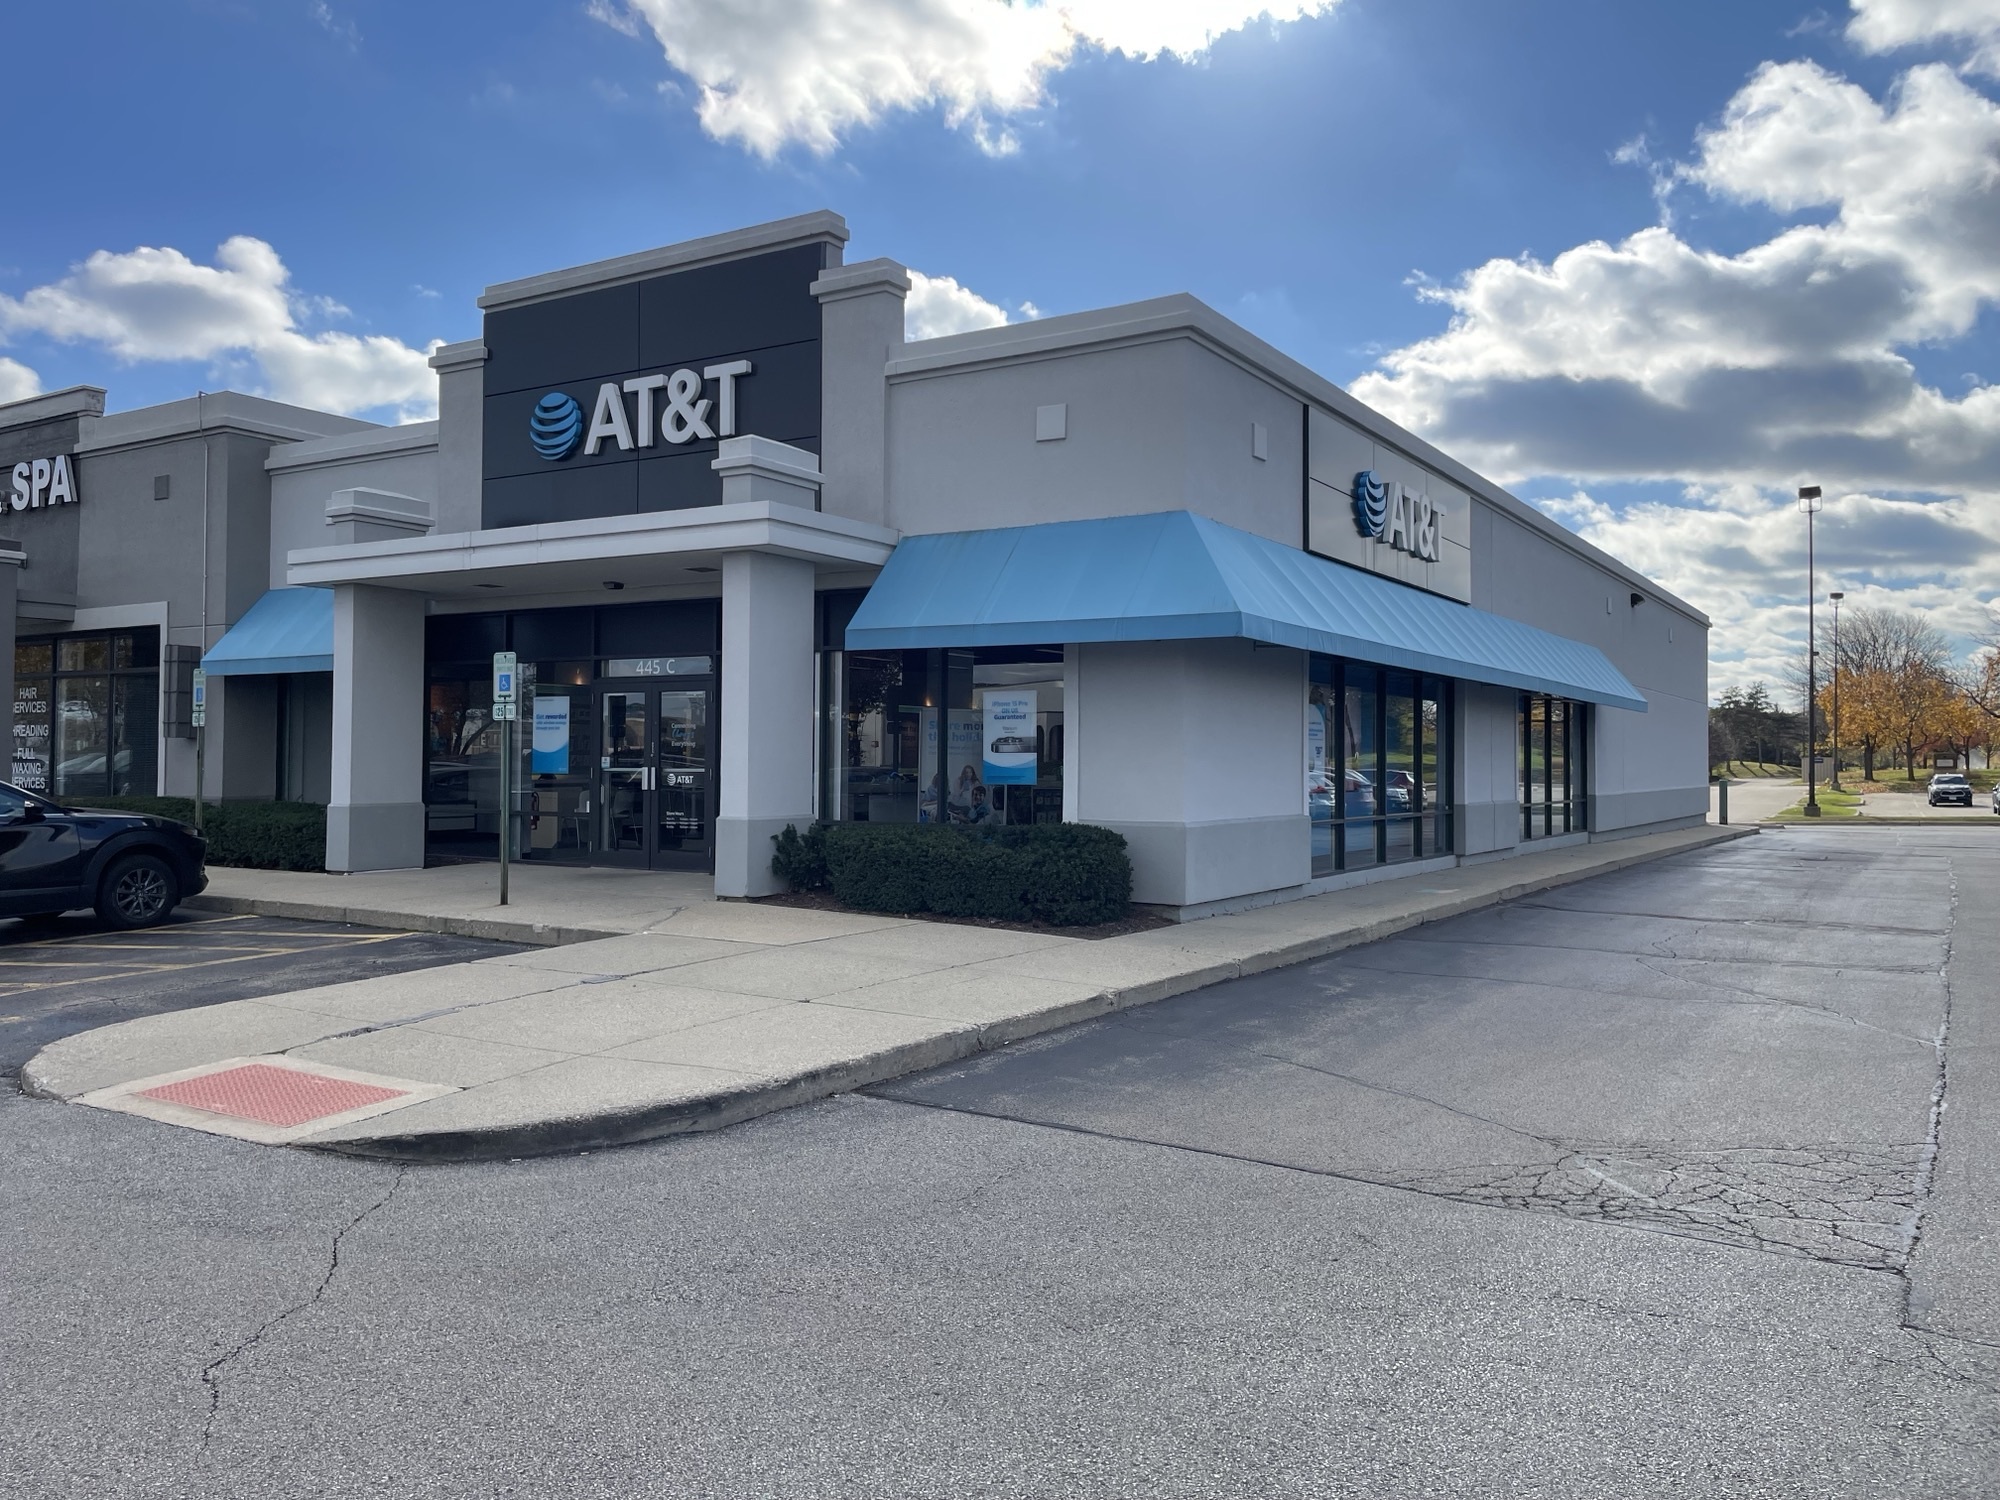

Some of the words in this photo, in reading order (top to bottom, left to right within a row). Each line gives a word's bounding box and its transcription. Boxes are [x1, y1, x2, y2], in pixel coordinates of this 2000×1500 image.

[583, 360, 752, 456] AT&T
[11, 455, 77, 511] SPA
[1383, 481, 1447, 562] AT&T
[636, 660, 660, 675] 445
[666, 659, 675, 674] C
[19, 687, 37, 699] HAIR
[13, 724, 49, 737] READING
[17, 747, 36, 760] FULL
[676, 775, 694, 784] AT&T
